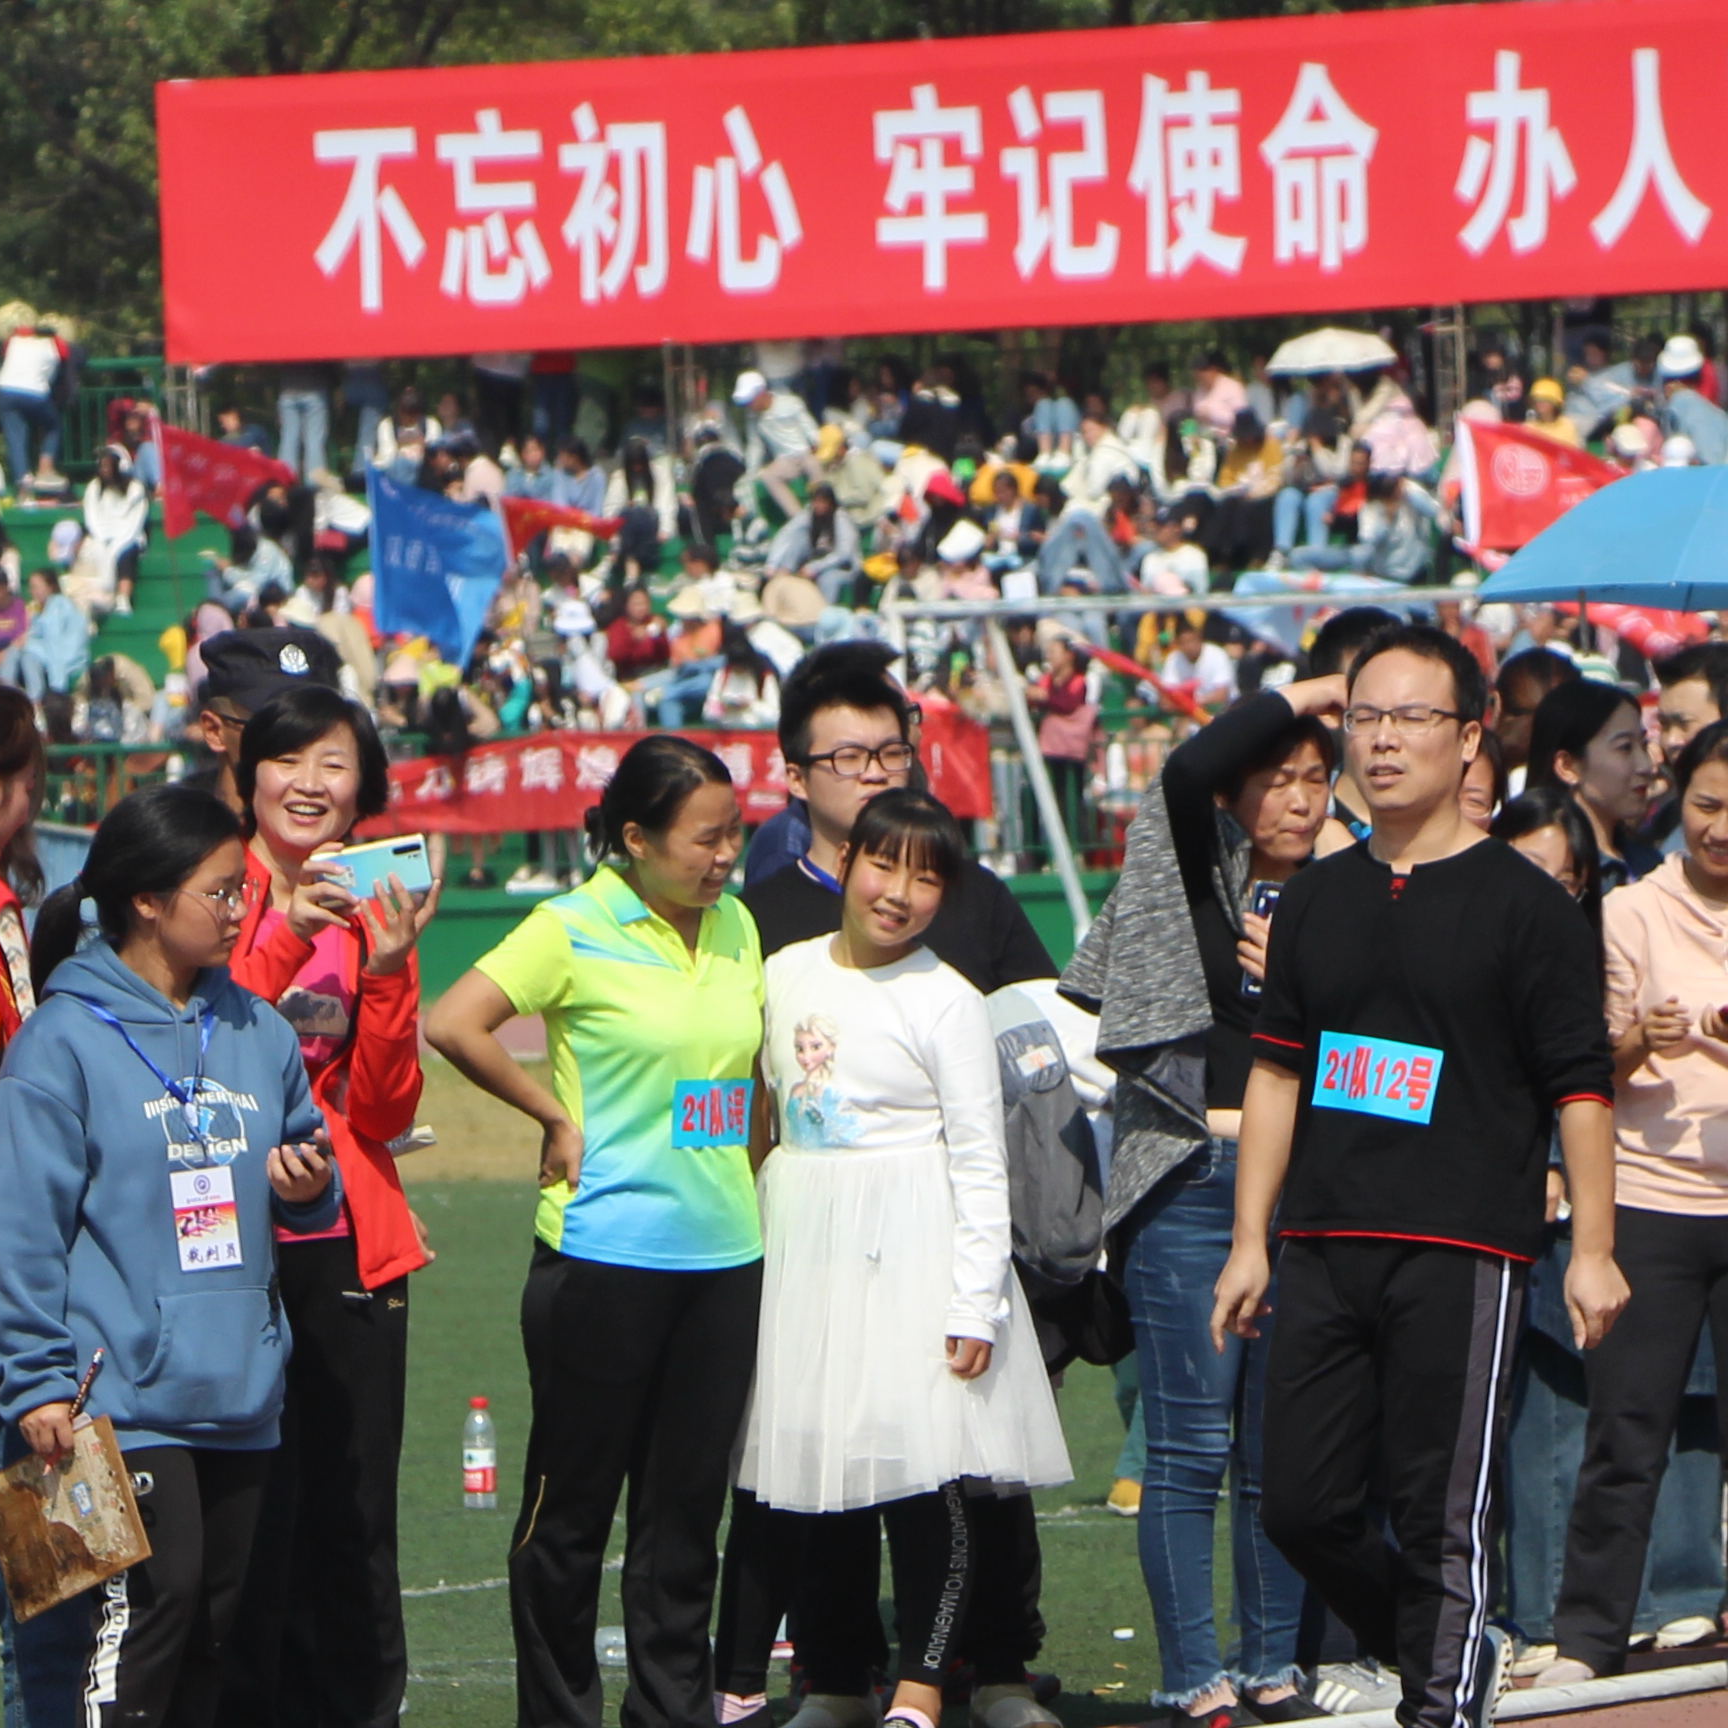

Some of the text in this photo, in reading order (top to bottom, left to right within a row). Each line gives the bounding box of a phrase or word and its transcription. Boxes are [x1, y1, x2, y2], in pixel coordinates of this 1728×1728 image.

[312, 101, 803, 313] 不忘初心
[872, 61, 1379, 292] 牢记使命
[1322, 1045, 1435, 1111] 21队12号
